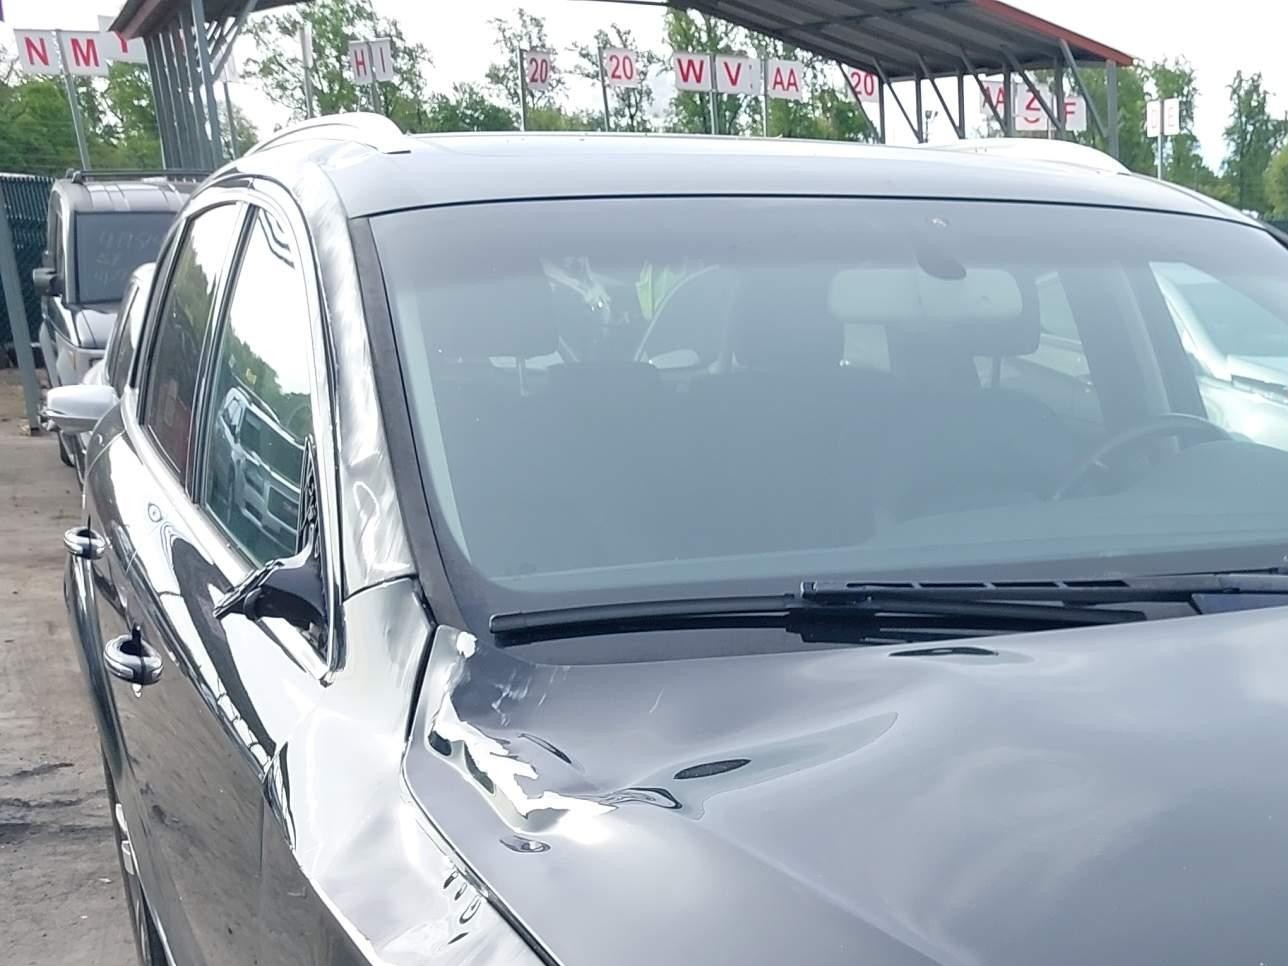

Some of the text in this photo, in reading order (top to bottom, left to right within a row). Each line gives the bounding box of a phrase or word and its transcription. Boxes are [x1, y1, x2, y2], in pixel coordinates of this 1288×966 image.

[24, 37, 49, 66] N
[70, 38, 99, 67] M
[354, 49, 367, 77] H
[529, 58, 548, 83] 20
[609, 55, 634, 80] 20
[677, 58, 704, 84] W
[724, 62, 742, 86] V
[773, 67, 799, 92] AA
[851, 71, 875, 97] 20
